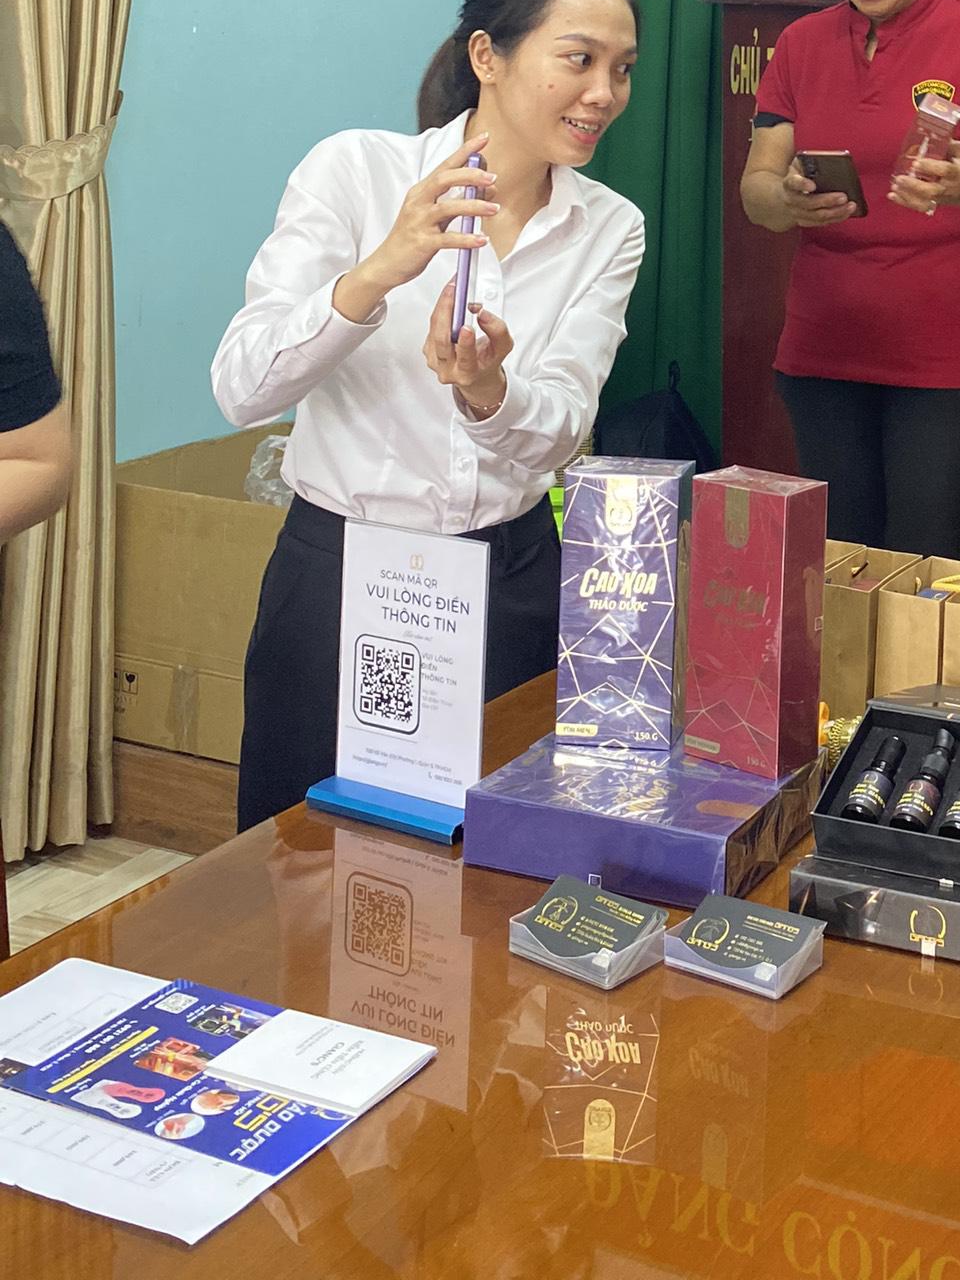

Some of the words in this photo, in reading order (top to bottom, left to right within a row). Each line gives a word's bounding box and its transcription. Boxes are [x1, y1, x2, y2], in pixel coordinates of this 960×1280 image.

[730, 27, 761, 96] CHỦ
[380, 569, 405, 583] SCAN
[424, 578, 438, 589] QR
[579, 567, 619, 598] CAO
[619, 570, 659, 599] XOA
[366, 583, 390, 600] VUI
[394, 587, 432, 608] LÒNG
[588, 596, 617, 610] THẢO
[381, 606, 430, 628] THÔNG
[434, 616, 457, 633] TIN
[651, 732, 659, 742] G
[228, 1119, 282, 1161] DƯỢC
